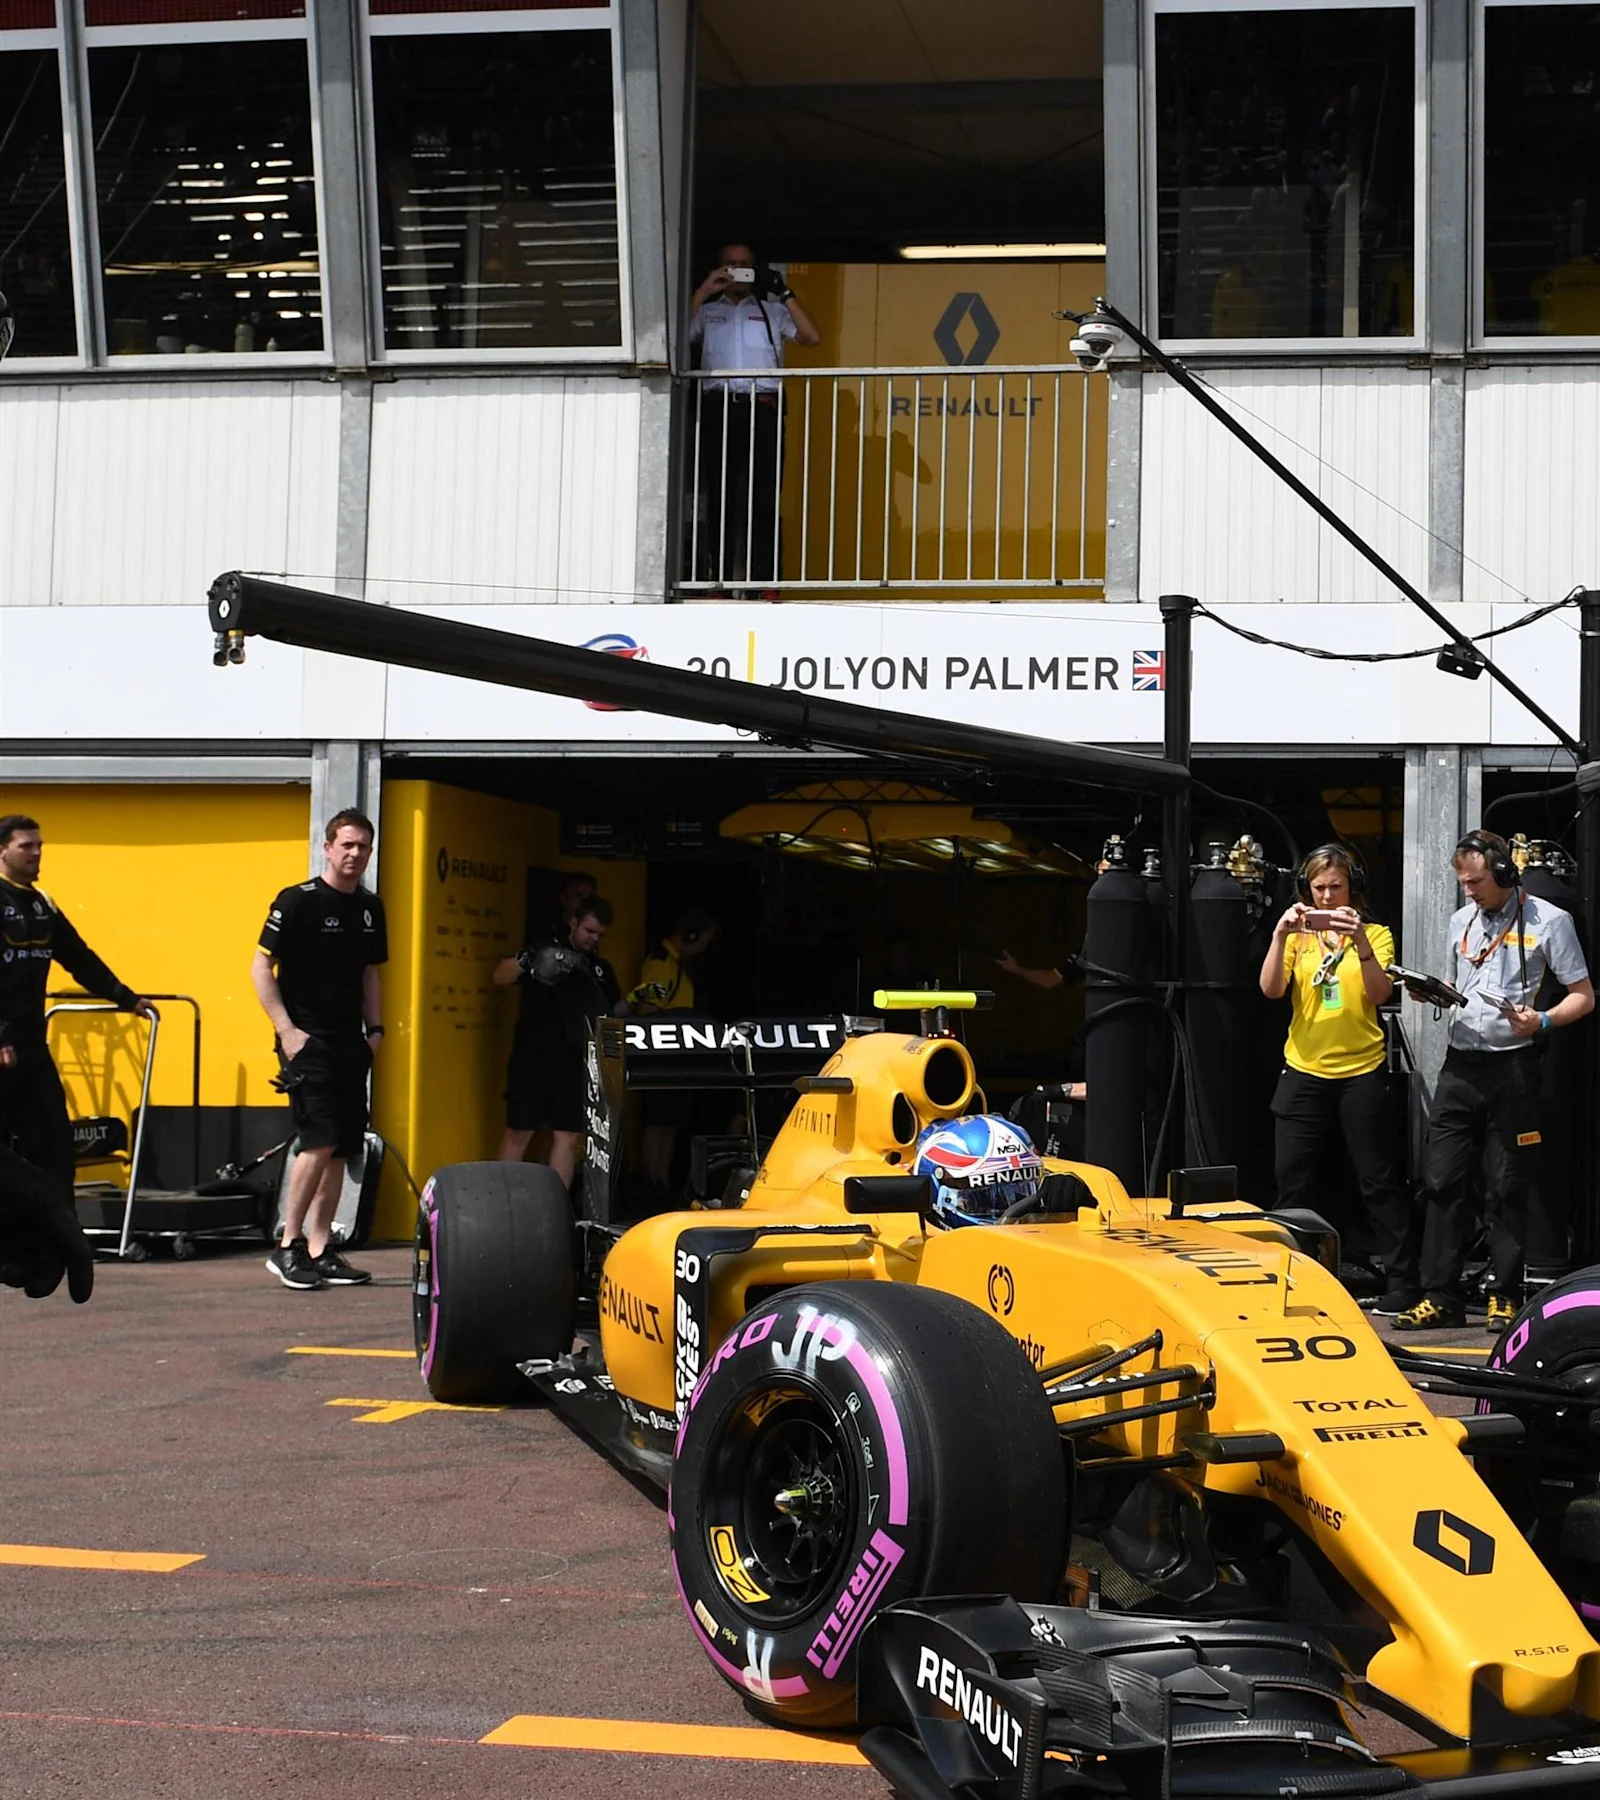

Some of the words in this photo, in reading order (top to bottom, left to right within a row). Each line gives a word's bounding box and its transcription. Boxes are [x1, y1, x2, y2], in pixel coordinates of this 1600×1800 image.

[891, 397, 1042, 417] RENAULT
[769, 656, 928, 690] JOLYON
[945, 656, 1120, 690] PALMER
[452, 857, 508, 883] RENAULT
[625, 1023, 837, 1050] RENAULT
[997, 1143, 1022, 1155] MSV
[968, 1166, 1044, 1189] RENAULT
[676, 1249, 700, 1284] 30
[1256, 1334, 1357, 1364] 30
[1292, 1398, 1409, 1413] TOTAL
[1312, 1421, 1429, 1443] PIRELLI
[806, 1527, 906, 1680] PIRELLI
[1513, 1644, 1570, 1658] R.S.16
[916, 1645, 1023, 1768] RENAULT
